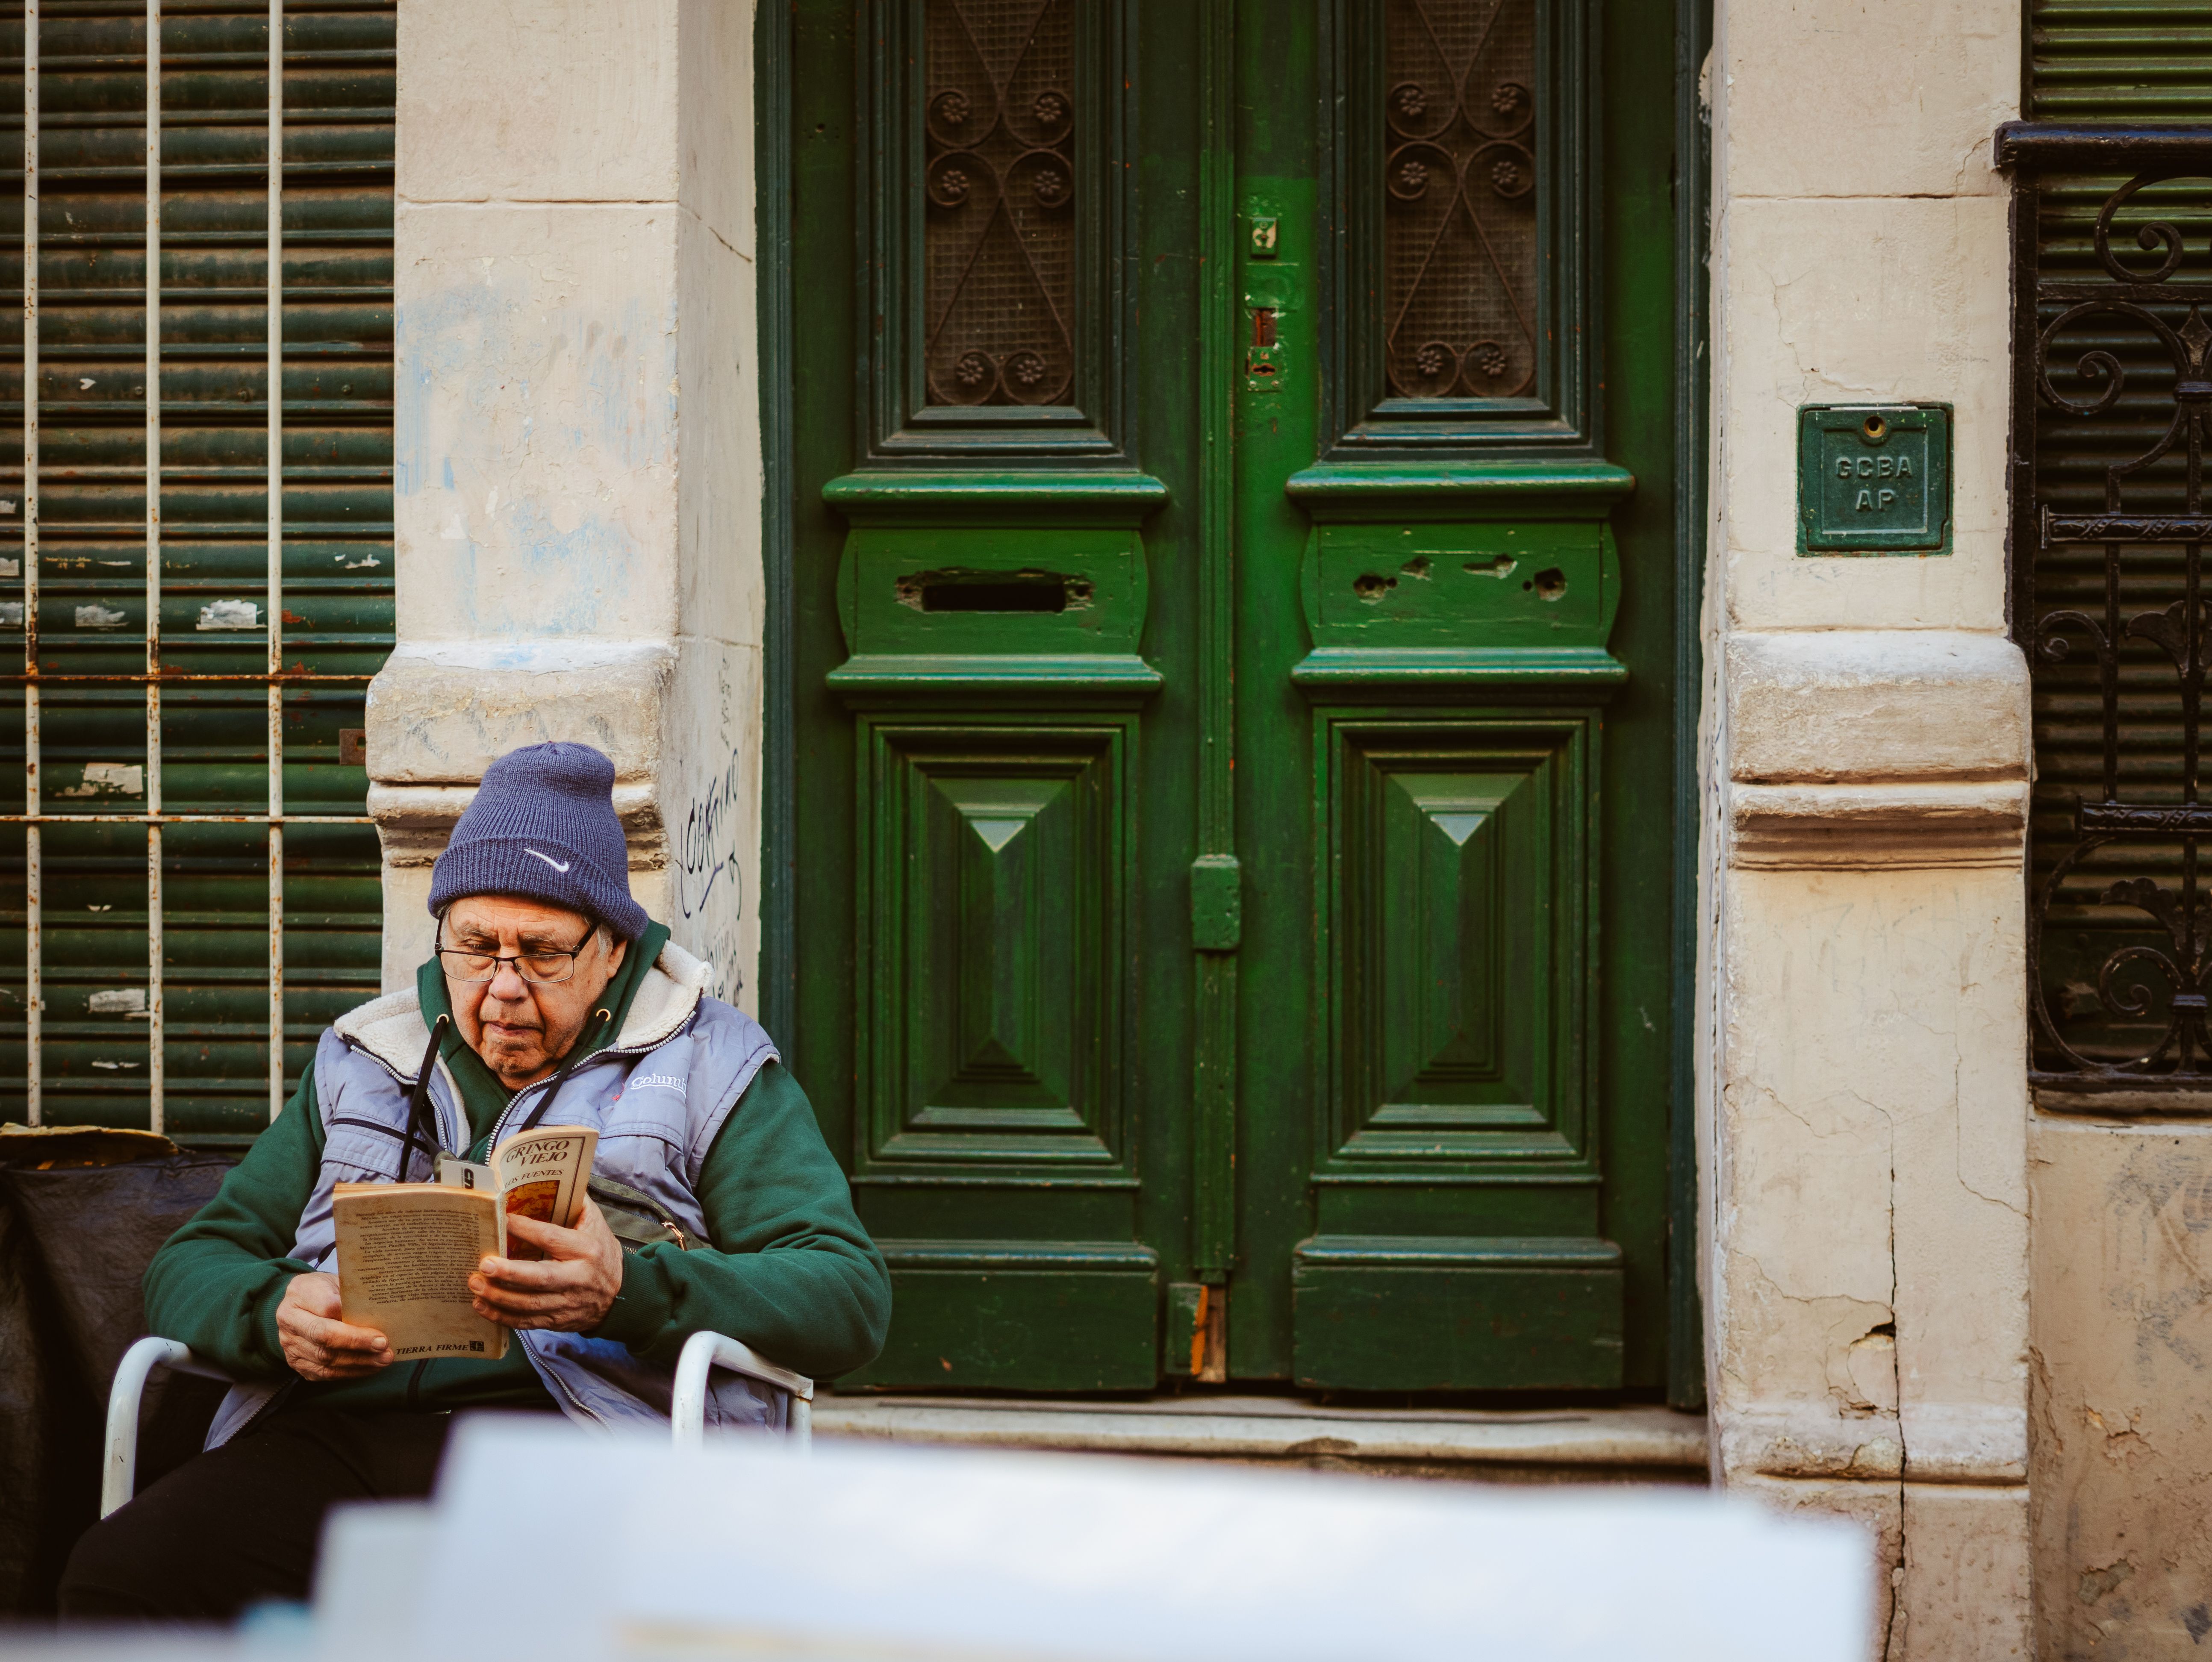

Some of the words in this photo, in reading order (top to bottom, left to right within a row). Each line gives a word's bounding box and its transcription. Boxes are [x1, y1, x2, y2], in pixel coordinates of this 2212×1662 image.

[1835, 455, 1913, 479] GCBA
[1855, 488, 1895, 512] AP
[631, 1073, 687, 1093] Columb
[506, 1140, 570, 1163] GRINGO
[521, 1151, 568, 1167] VIEJO
[521, 1169, 564, 1180] FUENTES
[396, 1345, 432, 1355] TIERRA
